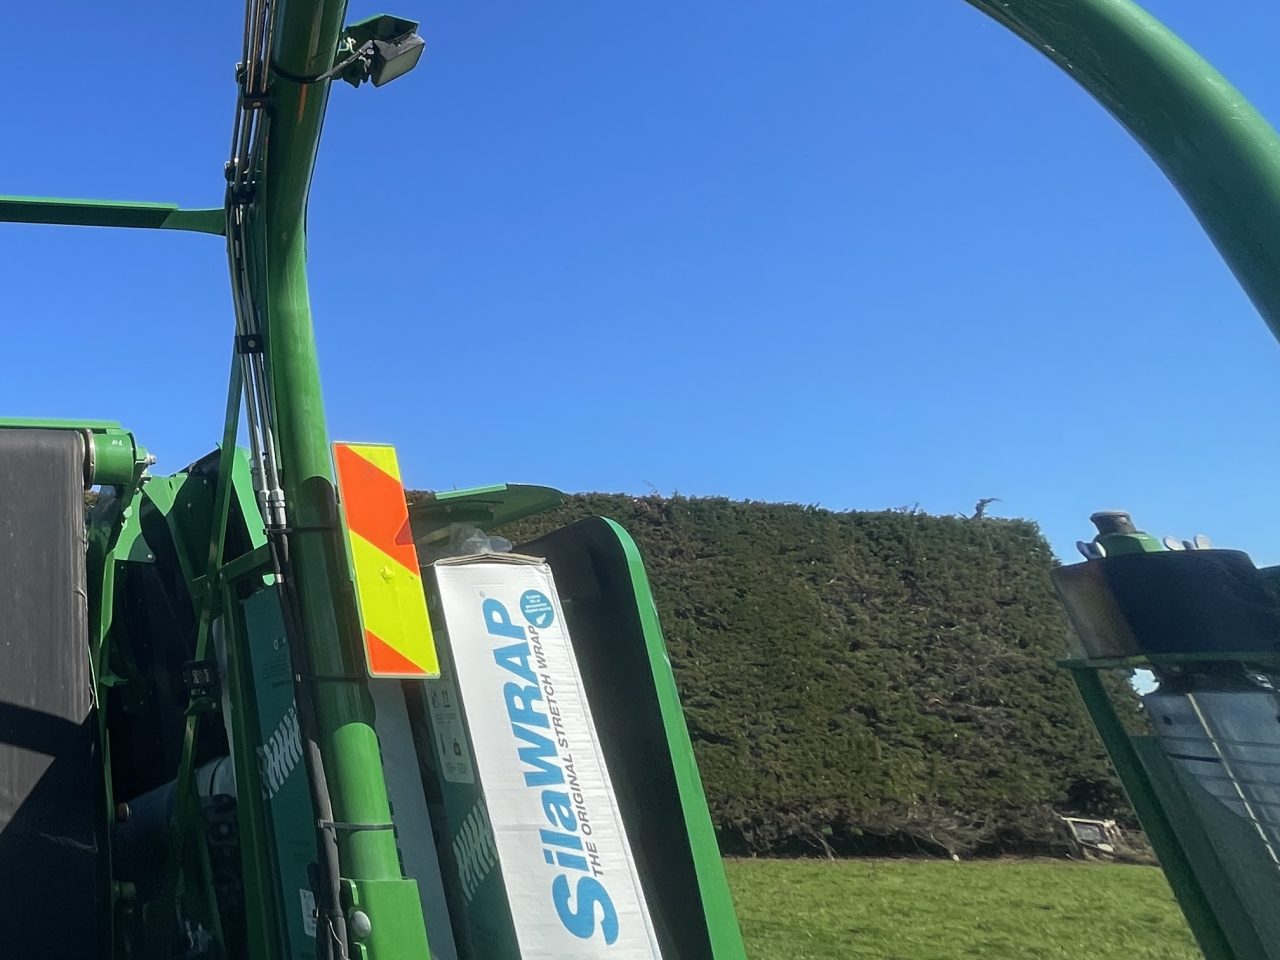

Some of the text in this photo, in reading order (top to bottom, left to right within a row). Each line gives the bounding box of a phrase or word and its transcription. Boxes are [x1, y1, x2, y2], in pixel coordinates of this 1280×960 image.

[528, 625, 548, 669] WRAP
[540, 674, 569, 749] STRETCH
[482, 598, 620, 946] SilaWRAP
[564, 753, 592, 836] ORIGINAL
[585, 841, 604, 877] THE
